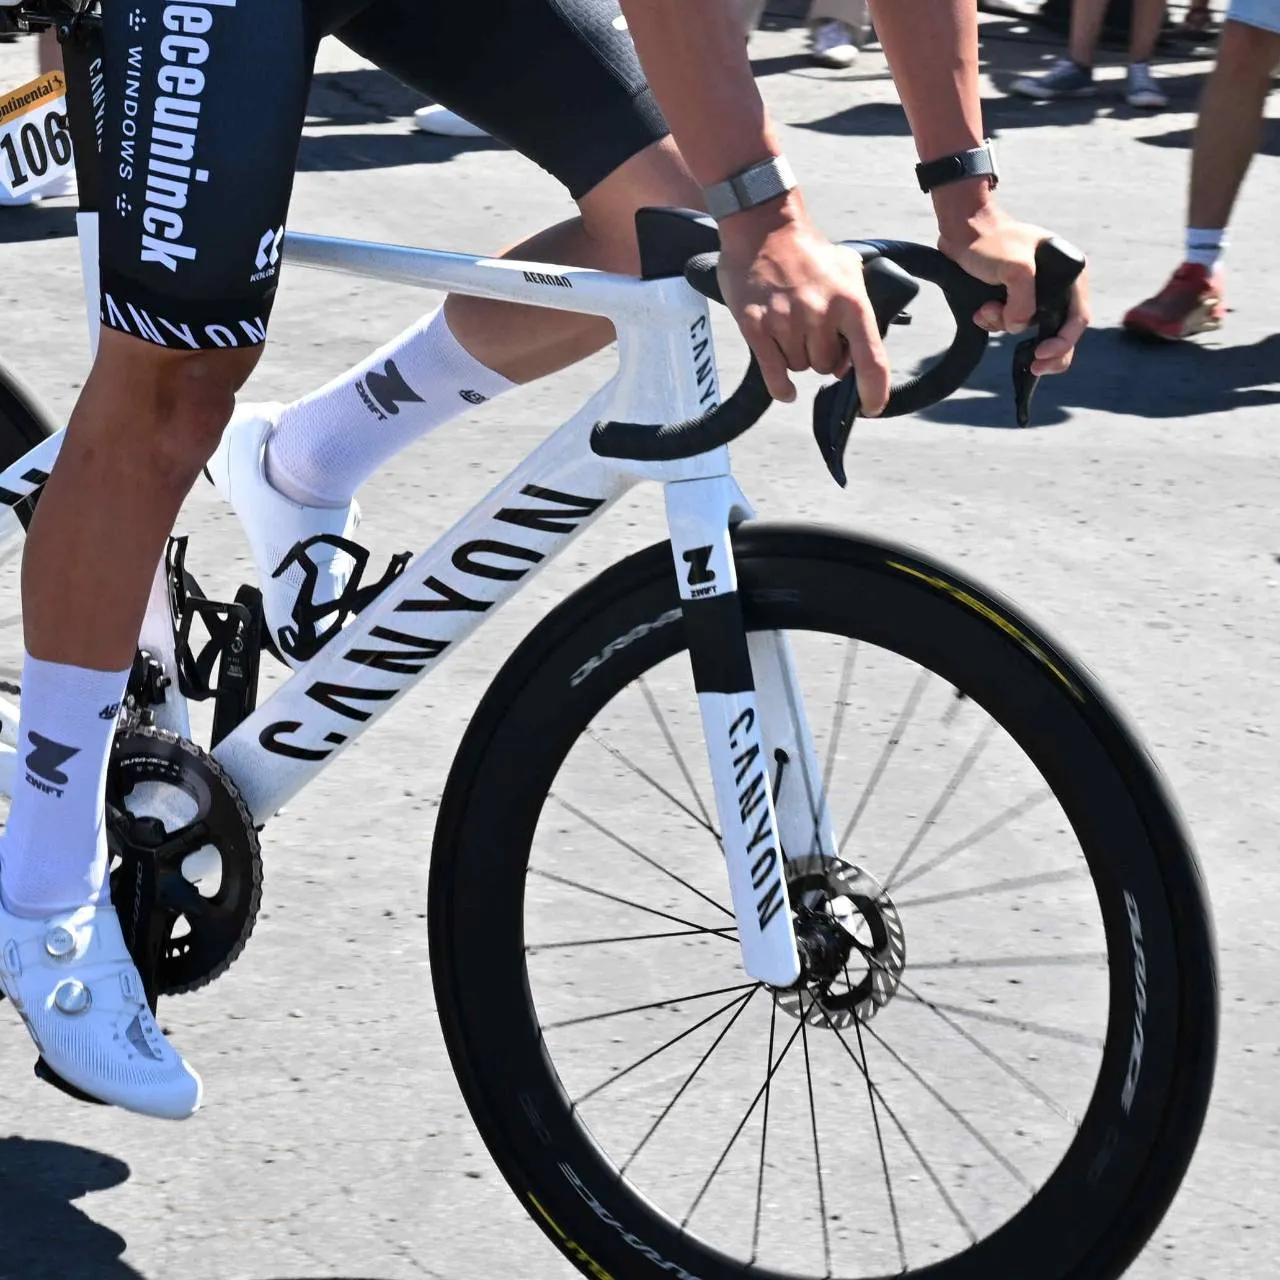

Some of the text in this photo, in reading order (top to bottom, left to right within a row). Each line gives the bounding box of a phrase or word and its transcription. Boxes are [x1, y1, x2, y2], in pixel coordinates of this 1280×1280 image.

[119, 46, 144, 180] WINDOWS
[0, 110, 71, 190] 106
[522, 270, 574, 289] AEROAD
[100, 292, 267, 350] ANYON
[354, 379, 389, 421] ZWIFT
[689, 583, 718, 599] ZWIFT
[258, 483, 608, 762] CANYON
[24, 771, 66, 800] ZWIFT
[728, 706, 786, 932] CANYON
